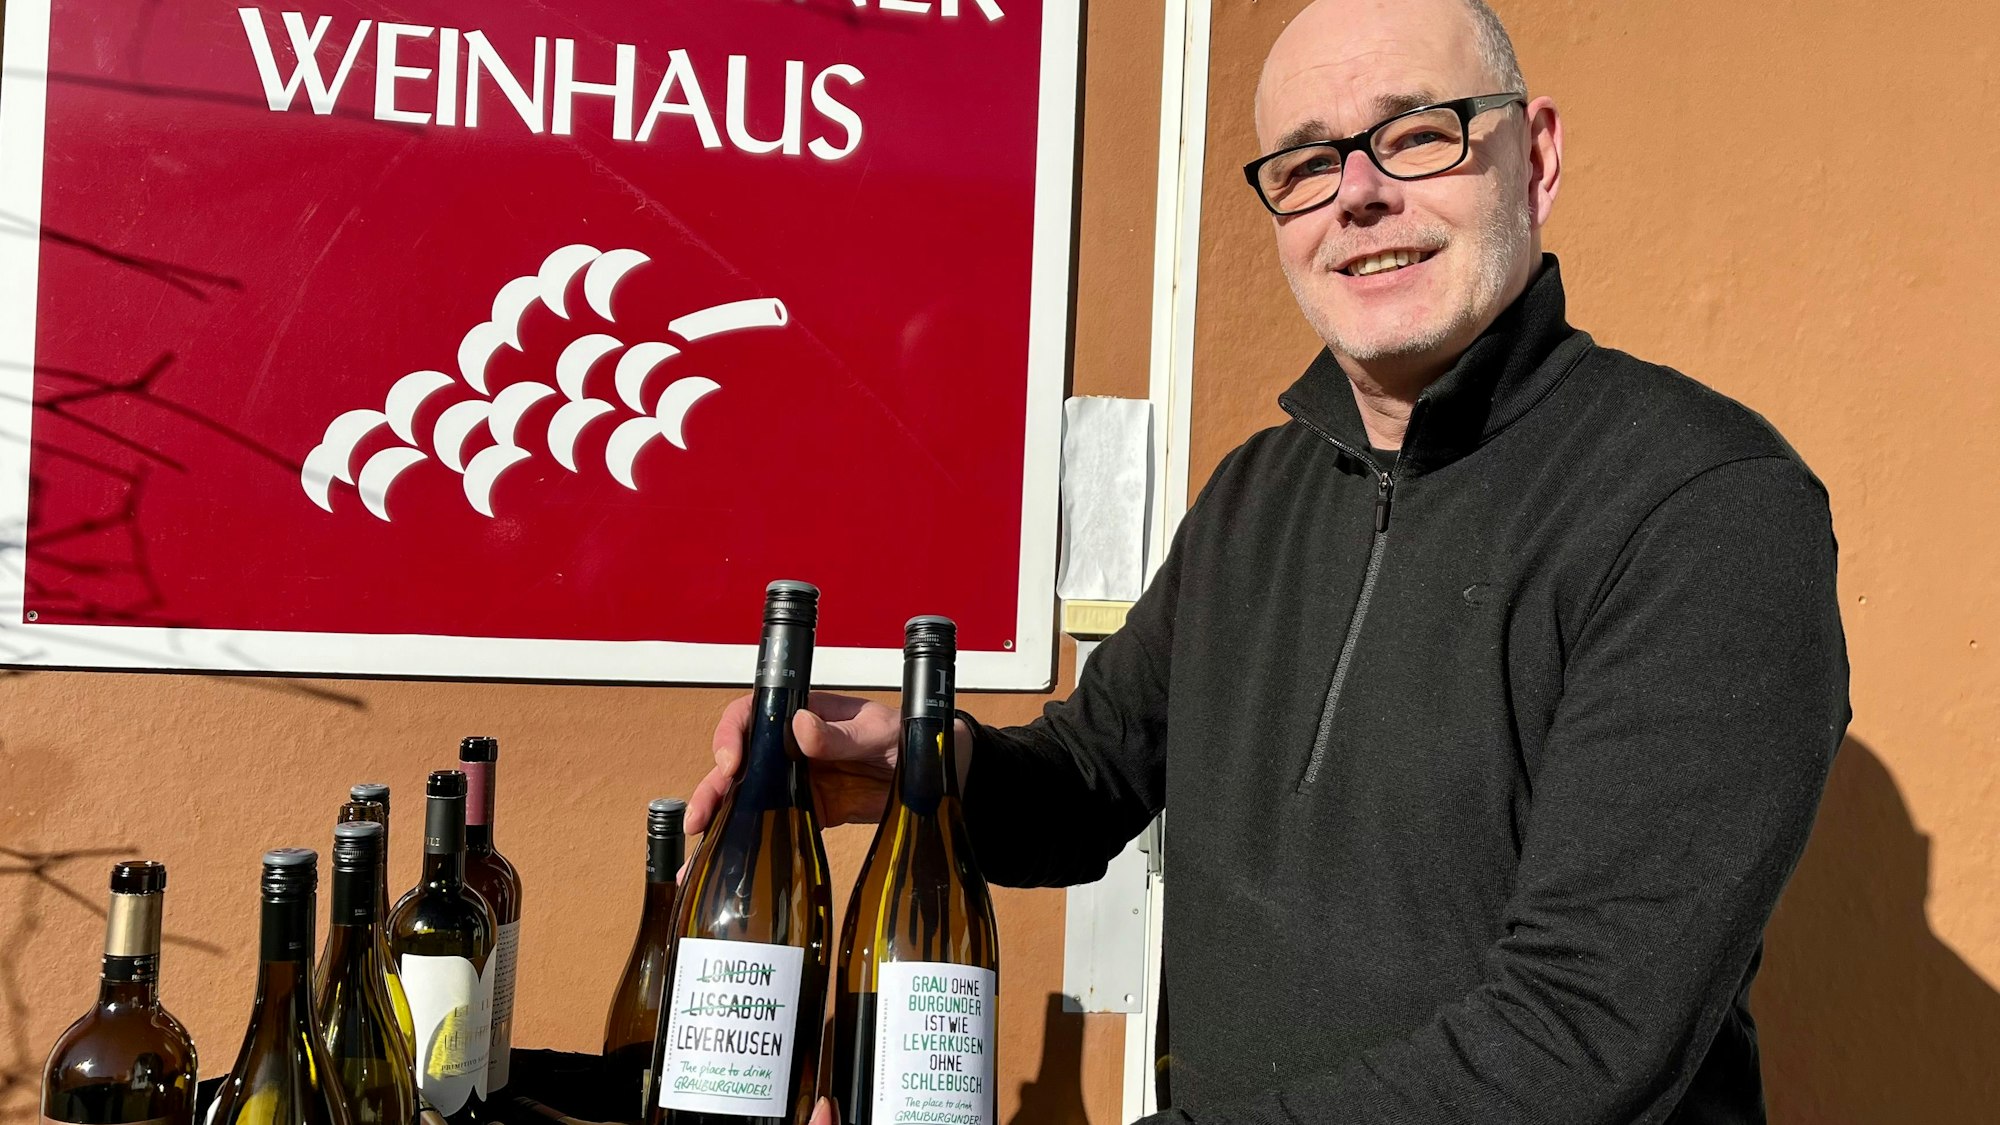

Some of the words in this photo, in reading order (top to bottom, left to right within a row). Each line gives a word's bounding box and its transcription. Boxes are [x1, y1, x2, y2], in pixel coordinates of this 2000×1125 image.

[238, 7, 865, 161] WEINHAUS
[702, 958, 772, 986] LONDON
[912, 975, 948, 993] GRAU
[951, 978, 980, 997] OHNE
[689, 991, 777, 1021] LISSABON
[908, 994, 982, 1017] BURGUNDER
[925, 1014, 945, 1032] IST
[948, 1016, 969, 1034] WIE
[677, 1025, 783, 1056] LEVERKUSEN
[903, 1033, 984, 1055] LEVERKUSEN
[680, 1060, 697, 1072] The
[700, 1061, 726, 1077] place
[728, 1063, 740, 1076] to
[743, 1064, 773, 1079] drink
[929, 1054, 963, 1072] OHNE
[674, 1076, 773, 1097] GRAUBURGUNDER!
[901, 1072, 982, 1094] SCHLEBUSCH
[905, 1096, 921, 1108] The
[921, 1097, 944, 1110] place
[945, 1098, 954, 1108] to
[955, 1099, 973, 1111] drink
[894, 1110, 982, 1125] GRAUBURGUNDER!
